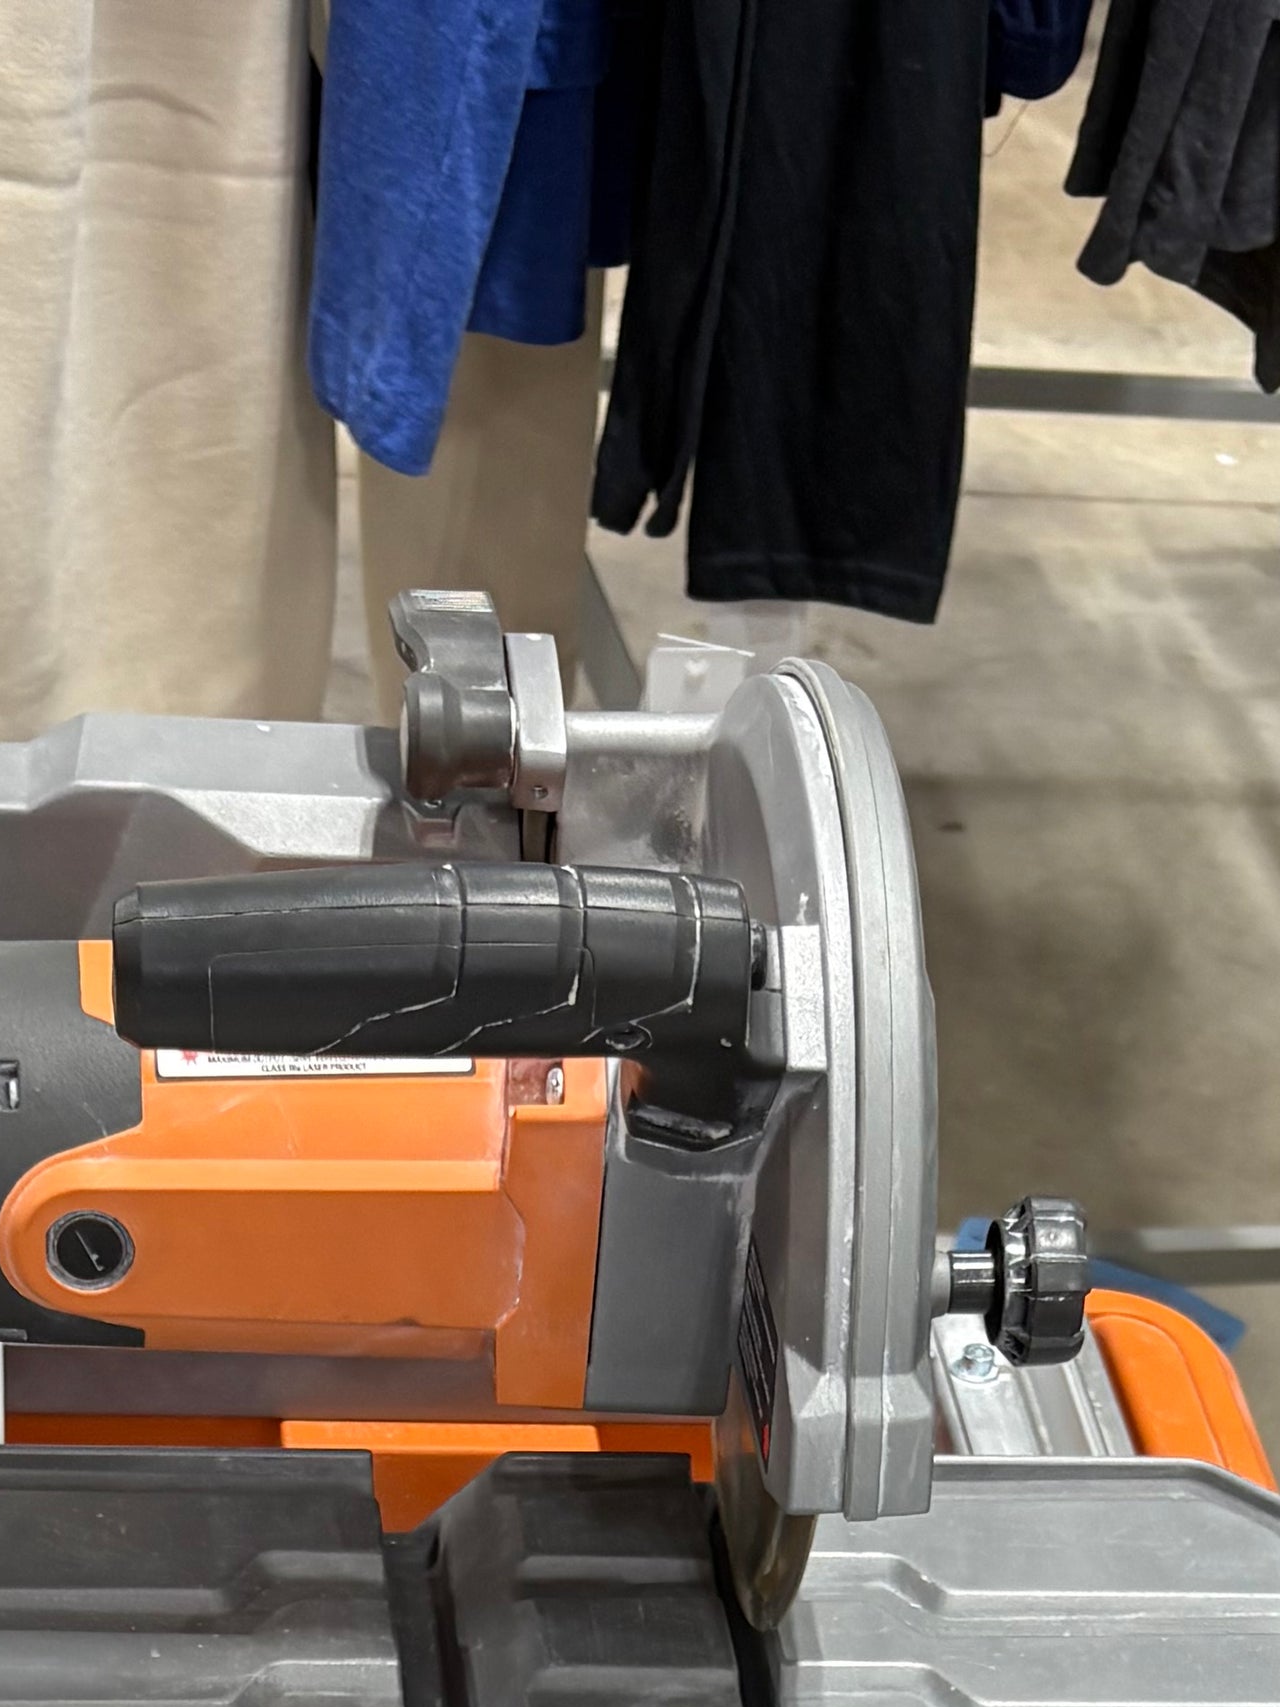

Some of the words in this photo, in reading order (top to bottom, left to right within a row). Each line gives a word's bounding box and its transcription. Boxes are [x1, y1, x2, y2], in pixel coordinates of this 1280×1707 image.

[261, 1063, 286, 1073] CLASS
[303, 1063, 328, 1072] LASER
[330, 1062, 367, 1071] PRODUCT
